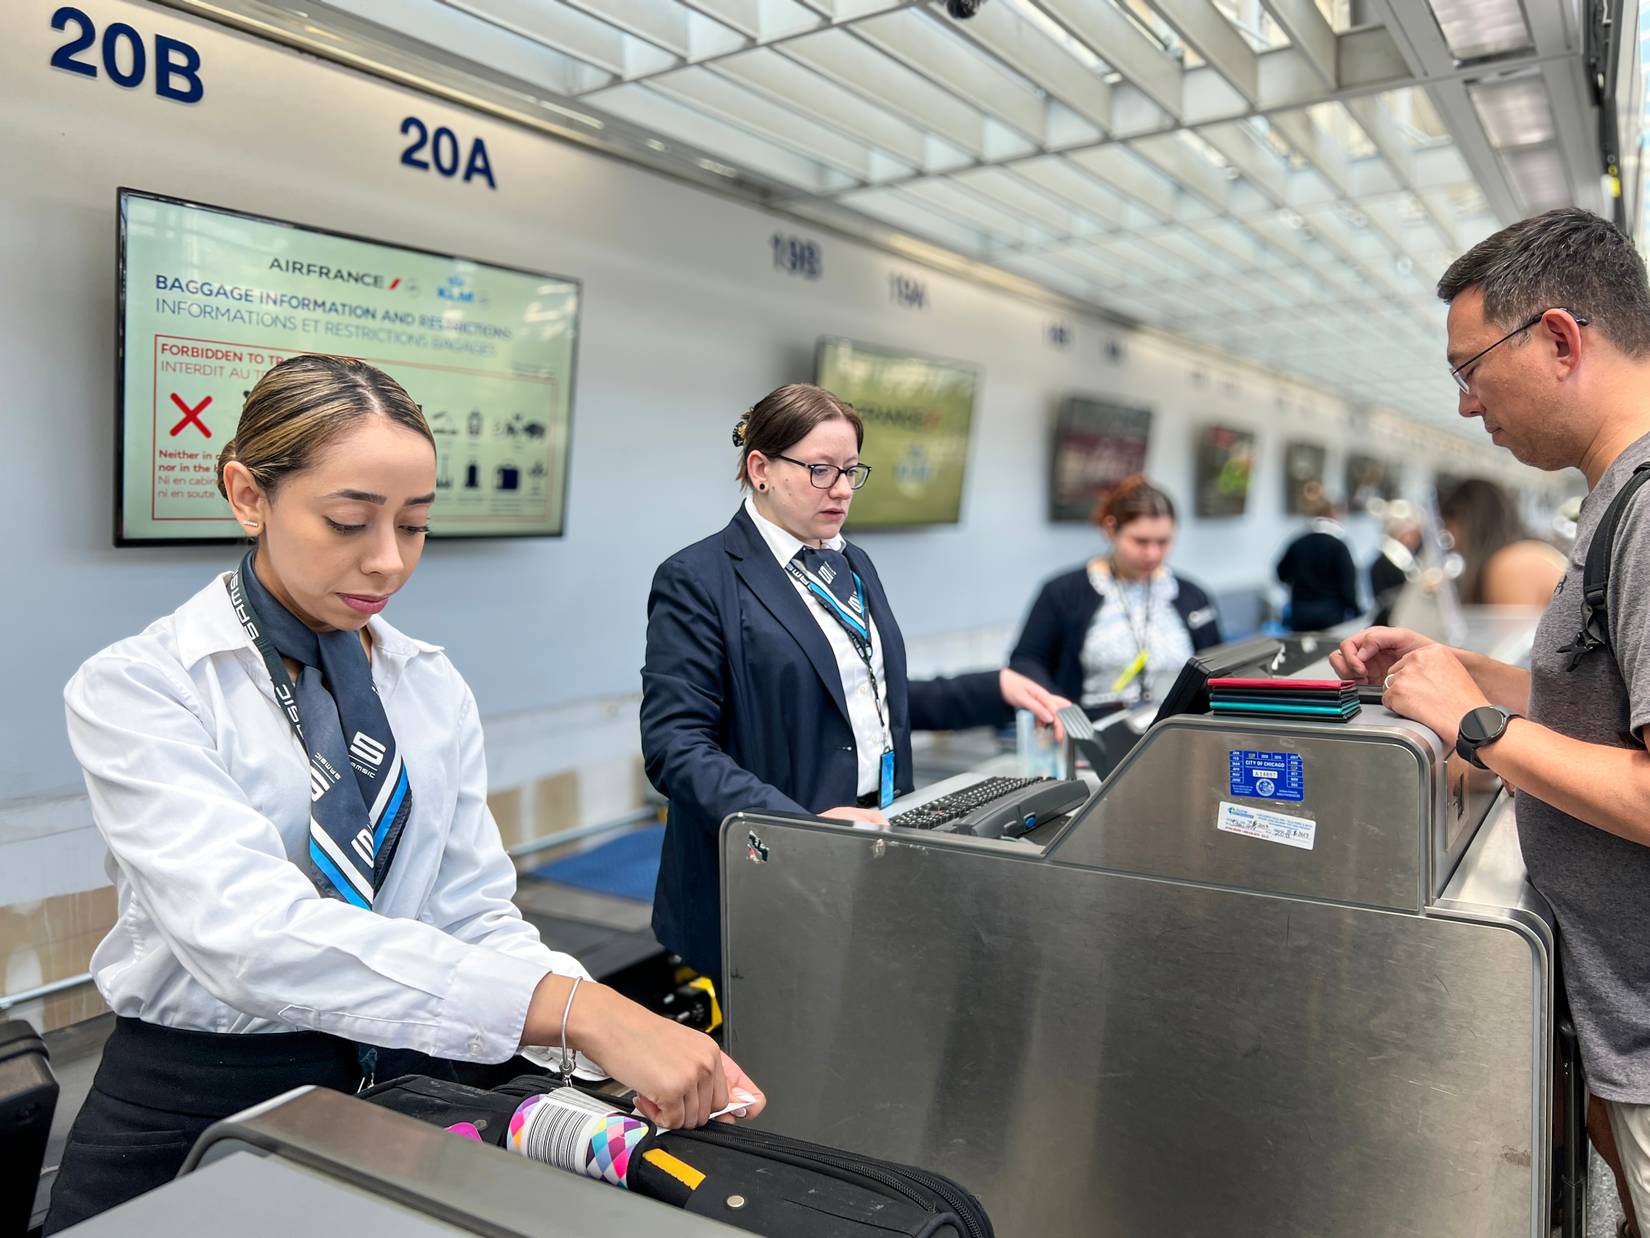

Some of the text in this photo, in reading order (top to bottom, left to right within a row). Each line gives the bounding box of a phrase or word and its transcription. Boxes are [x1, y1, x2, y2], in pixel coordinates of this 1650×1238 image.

[51, 6, 204, 104] 20B
[400, 116, 497, 191] 20A
[269, 257, 385, 289] AIRFRANCE
[155, 274, 254, 303] BAGGAGE
[259, 290, 377, 320] INFORMATION
[382, 310, 416, 327] AND
[156, 297, 297, 331] INFORMATIONS
[302, 317, 321, 333] ET
[325, 322, 428, 349] RESTRICTIONS
[161, 343, 243, 362] FORBIDDEN
[248, 352, 265, 365] TO
[161, 360, 225, 377] INTERDIT
[229, 366, 250, 380] AU
[158, 449, 200, 460] Neither
[202, 450, 212, 460] in
[158, 464, 177, 472] nor
[180, 463, 190, 472] in
[193, 463, 211, 473] the
[158, 475, 170, 484] Ni
[158, 489, 215, 499] ni en soute
